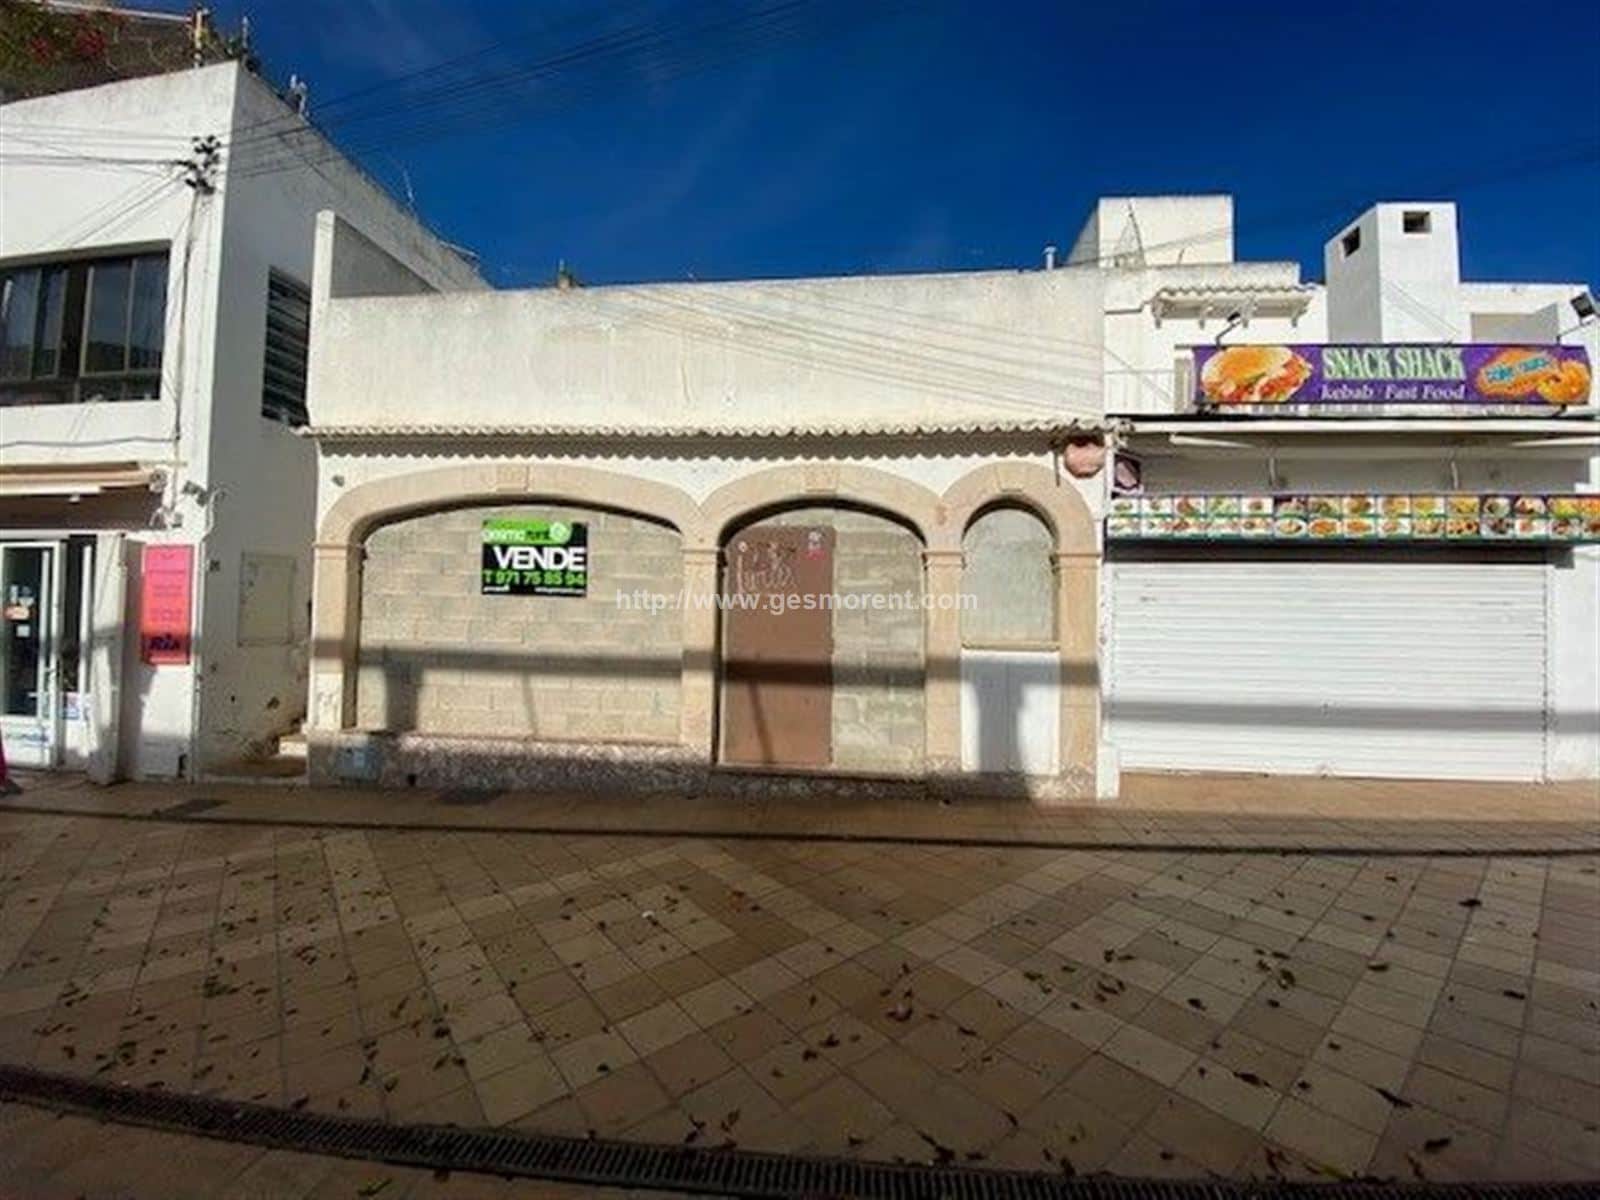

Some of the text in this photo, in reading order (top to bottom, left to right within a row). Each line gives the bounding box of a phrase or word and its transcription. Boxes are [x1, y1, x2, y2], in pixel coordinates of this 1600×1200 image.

[1322, 348, 1393, 379] SNACK
[1394, 348, 1467, 380] SHACK
[1385, 384, 1417, 400] Fast
[1422, 384, 1466, 400] Food
[493, 545, 585, 570] VENDE
